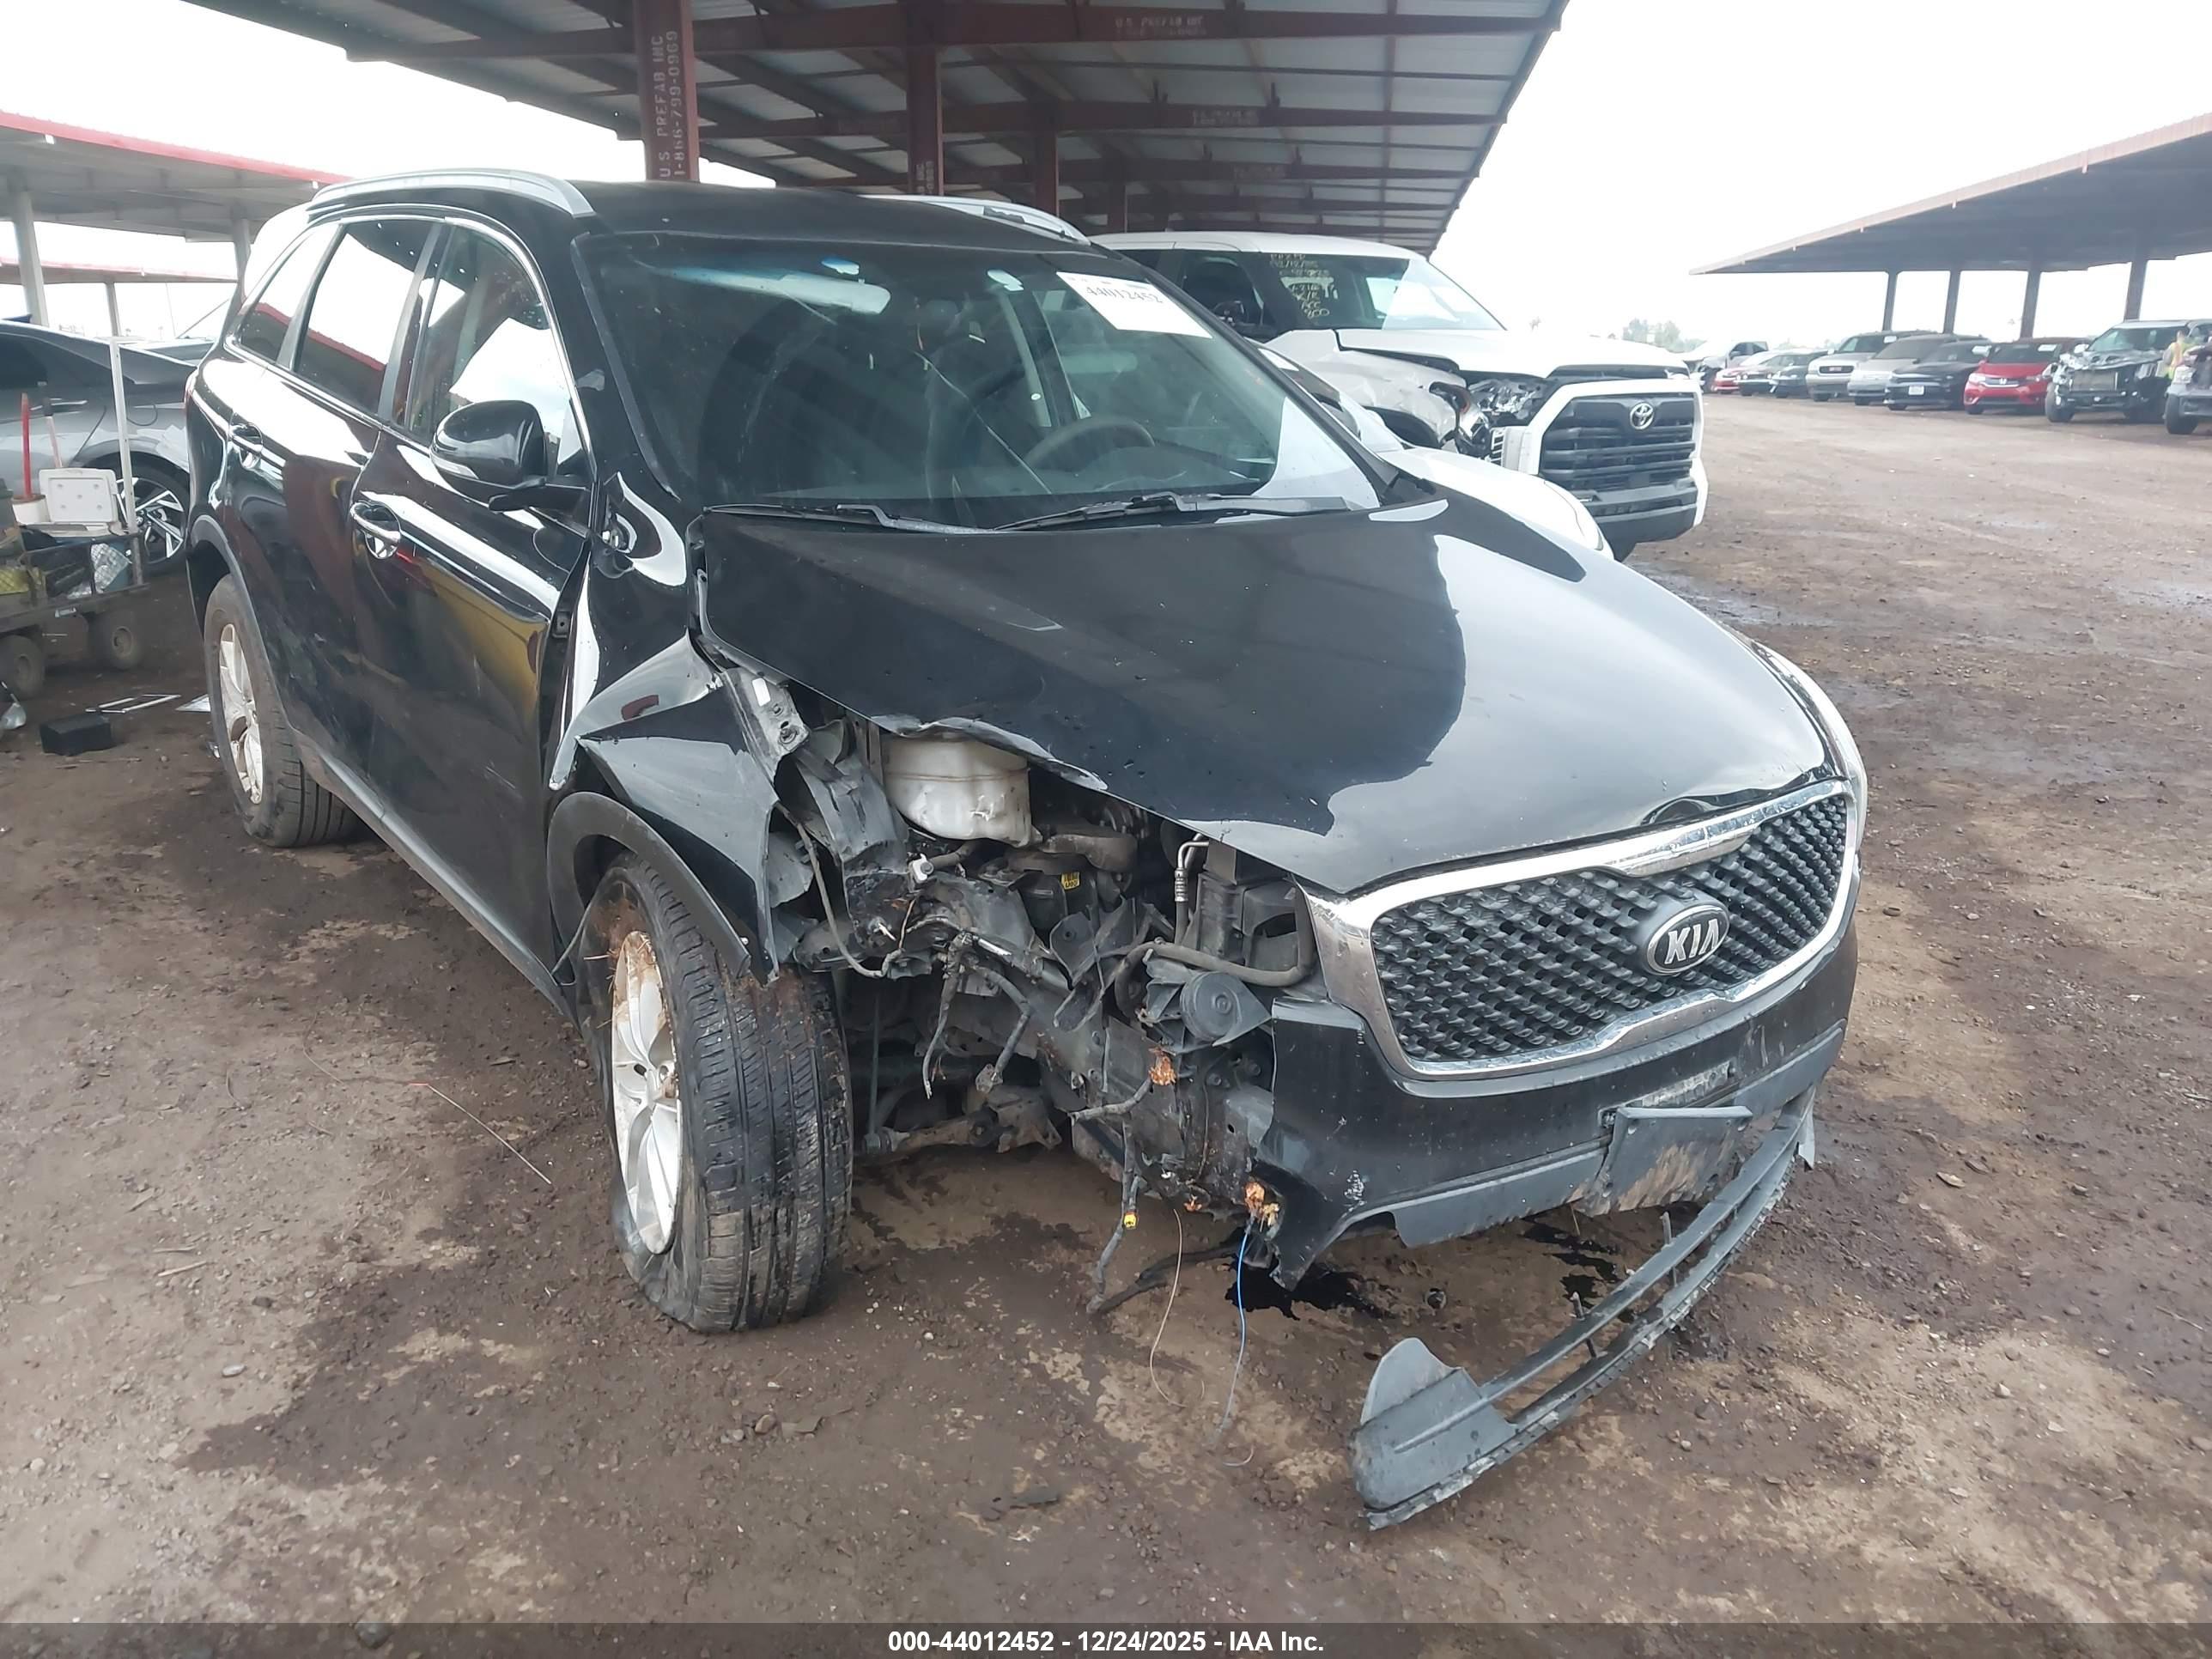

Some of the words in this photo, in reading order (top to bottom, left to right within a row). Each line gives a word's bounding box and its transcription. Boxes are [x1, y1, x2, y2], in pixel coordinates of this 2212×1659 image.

[651, 36, 664, 63] INC
[653, 71, 668, 137] PREFAB
[1665, 919, 1719, 964] KIA
